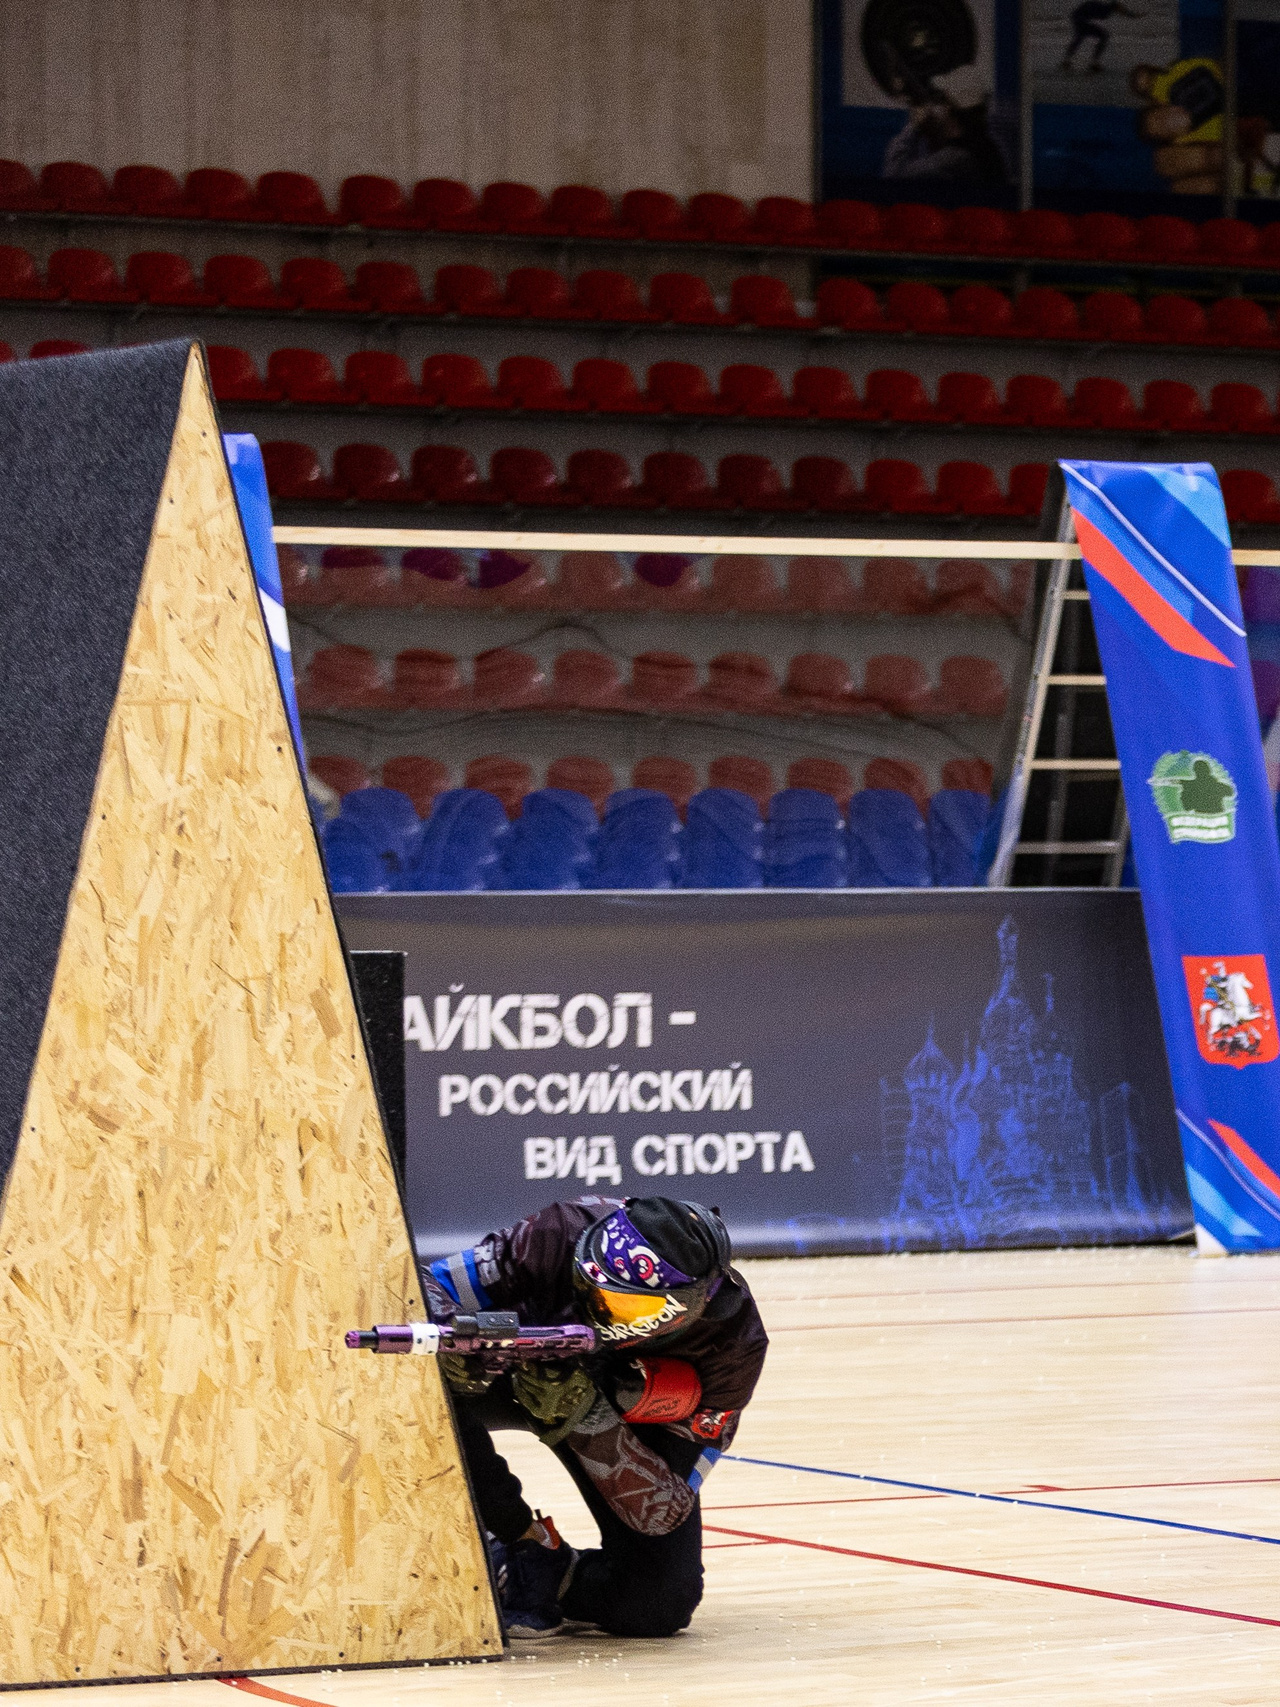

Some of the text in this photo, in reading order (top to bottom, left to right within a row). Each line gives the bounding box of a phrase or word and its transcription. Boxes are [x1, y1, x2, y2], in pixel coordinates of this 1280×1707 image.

[403, 983, 652, 1051] АЙКБОЛ
[438, 1062, 753, 1117] РОССИЙСКИЙ
[524, 1131, 815, 1186] ВИД СПОРТА
